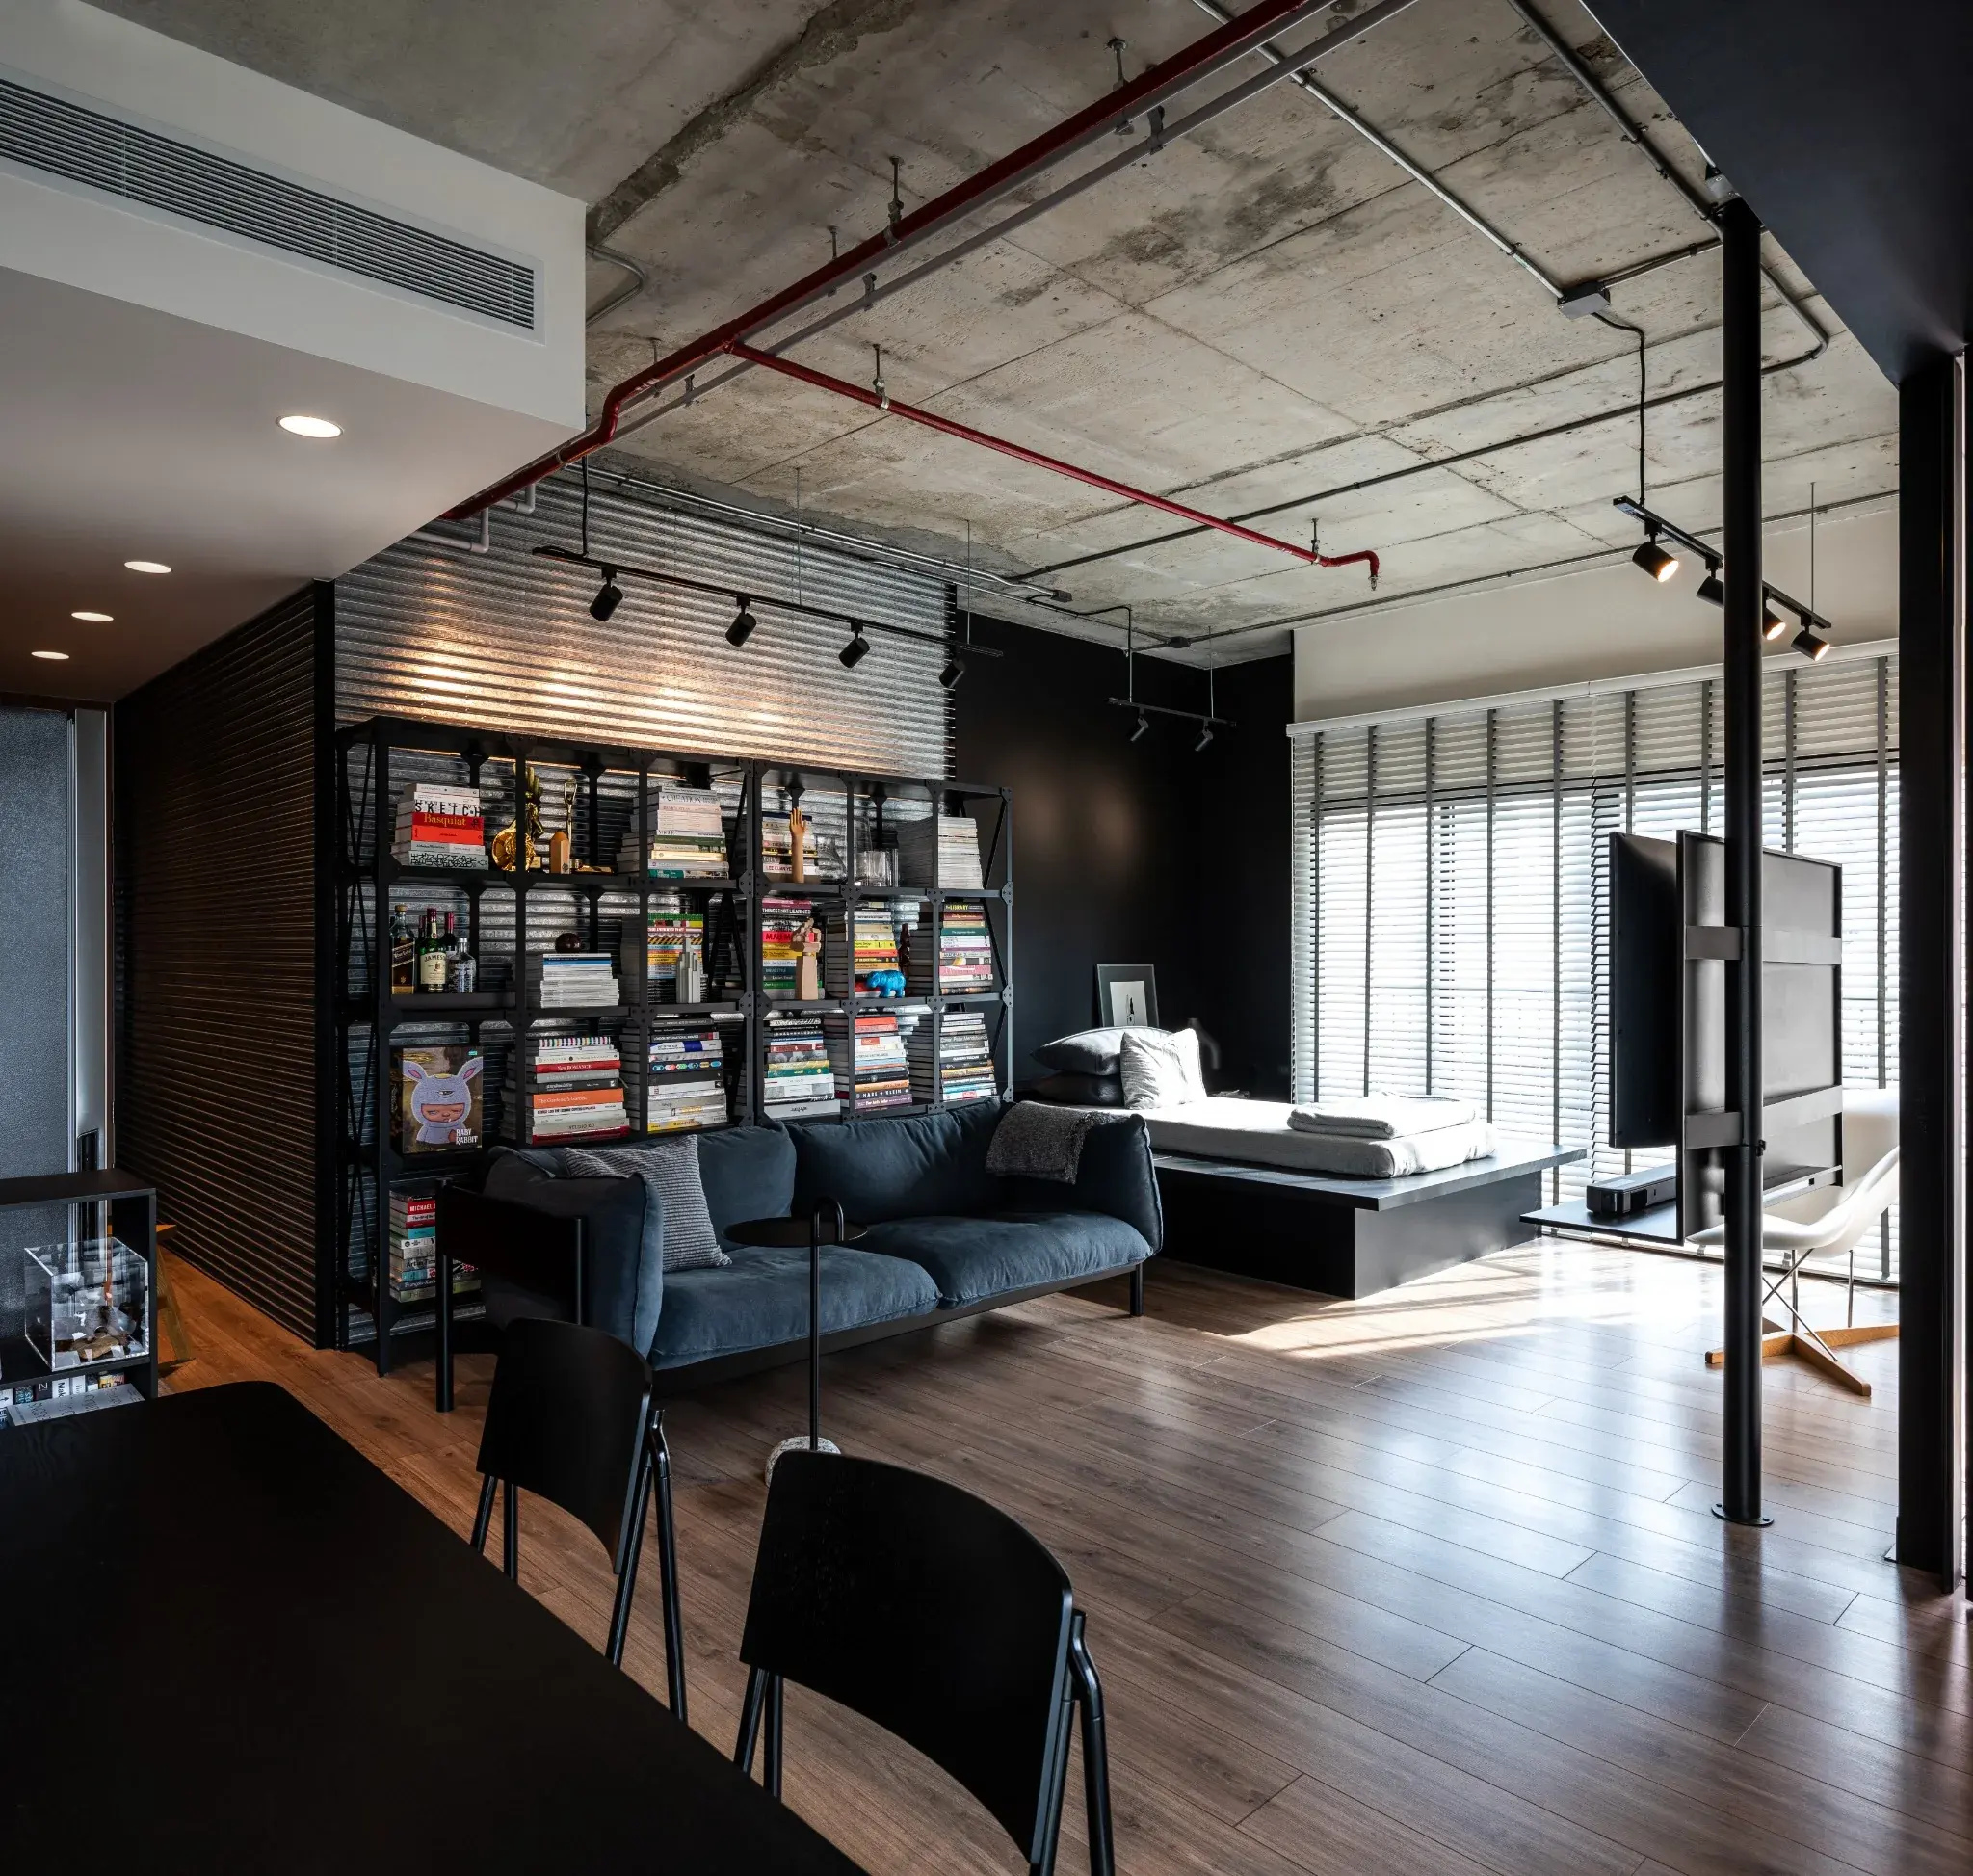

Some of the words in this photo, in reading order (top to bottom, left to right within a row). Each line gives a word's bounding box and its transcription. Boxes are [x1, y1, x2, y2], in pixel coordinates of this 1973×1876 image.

[424, 813, 466, 827] Basquiat
[456, 1128, 472, 1137] BABY
[455, 1135, 479, 1146] RABBIT
[409, 1203, 433, 1212] MICHAEL
